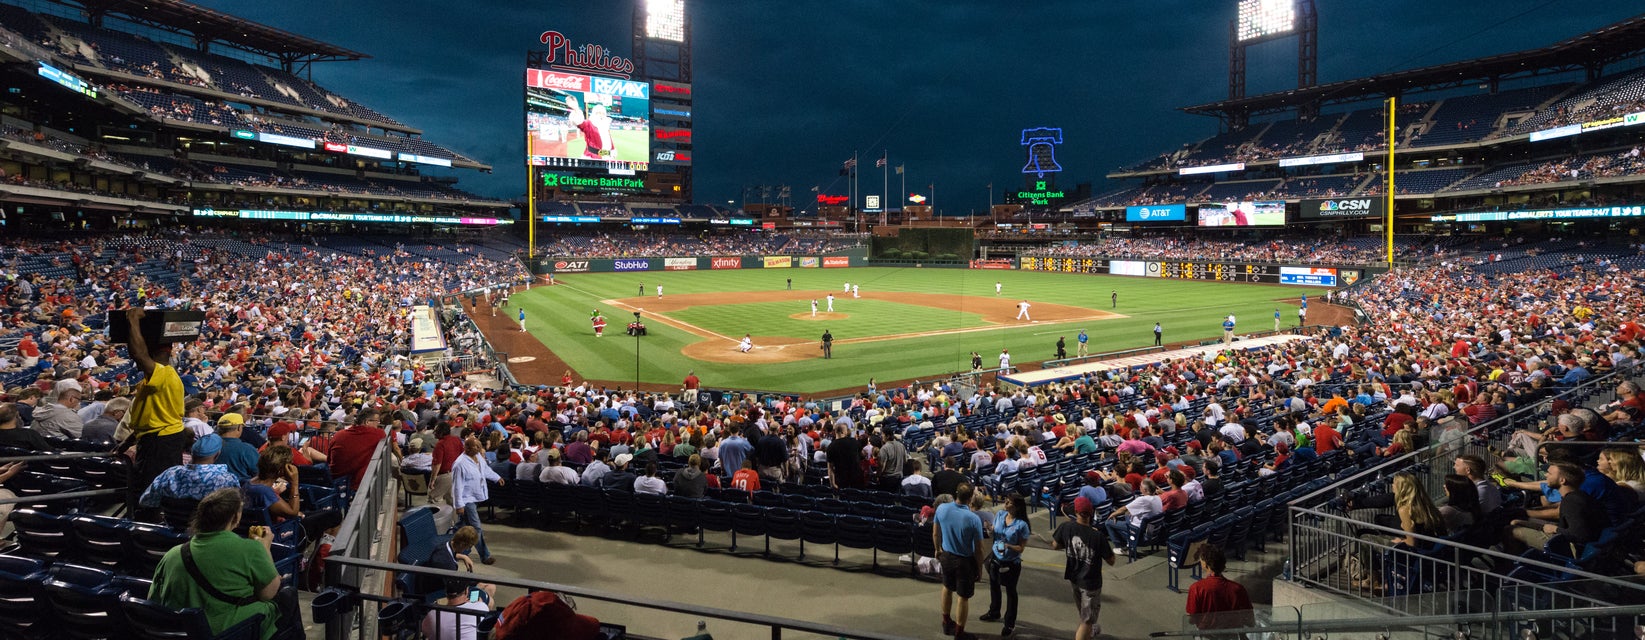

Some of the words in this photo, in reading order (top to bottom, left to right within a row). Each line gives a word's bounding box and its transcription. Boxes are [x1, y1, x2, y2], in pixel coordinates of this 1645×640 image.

[540, 31, 634, 73] Phillies
[560, 176, 599, 186] Citizens
[600, 177, 623, 187] Bank
[625, 178, 644, 188] Park
[1018, 191, 1046, 199] Citizens
[1032, 198, 1049, 206] Park
[1338, 199, 1372, 210] CSN
[1151, 209, 1171, 217] AT&T
[566, 261, 589, 269] ATI
[614, 260, 649, 270] StubHub
[713, 258, 740, 268] xfinity
[735, 479, 748, 491] 19
